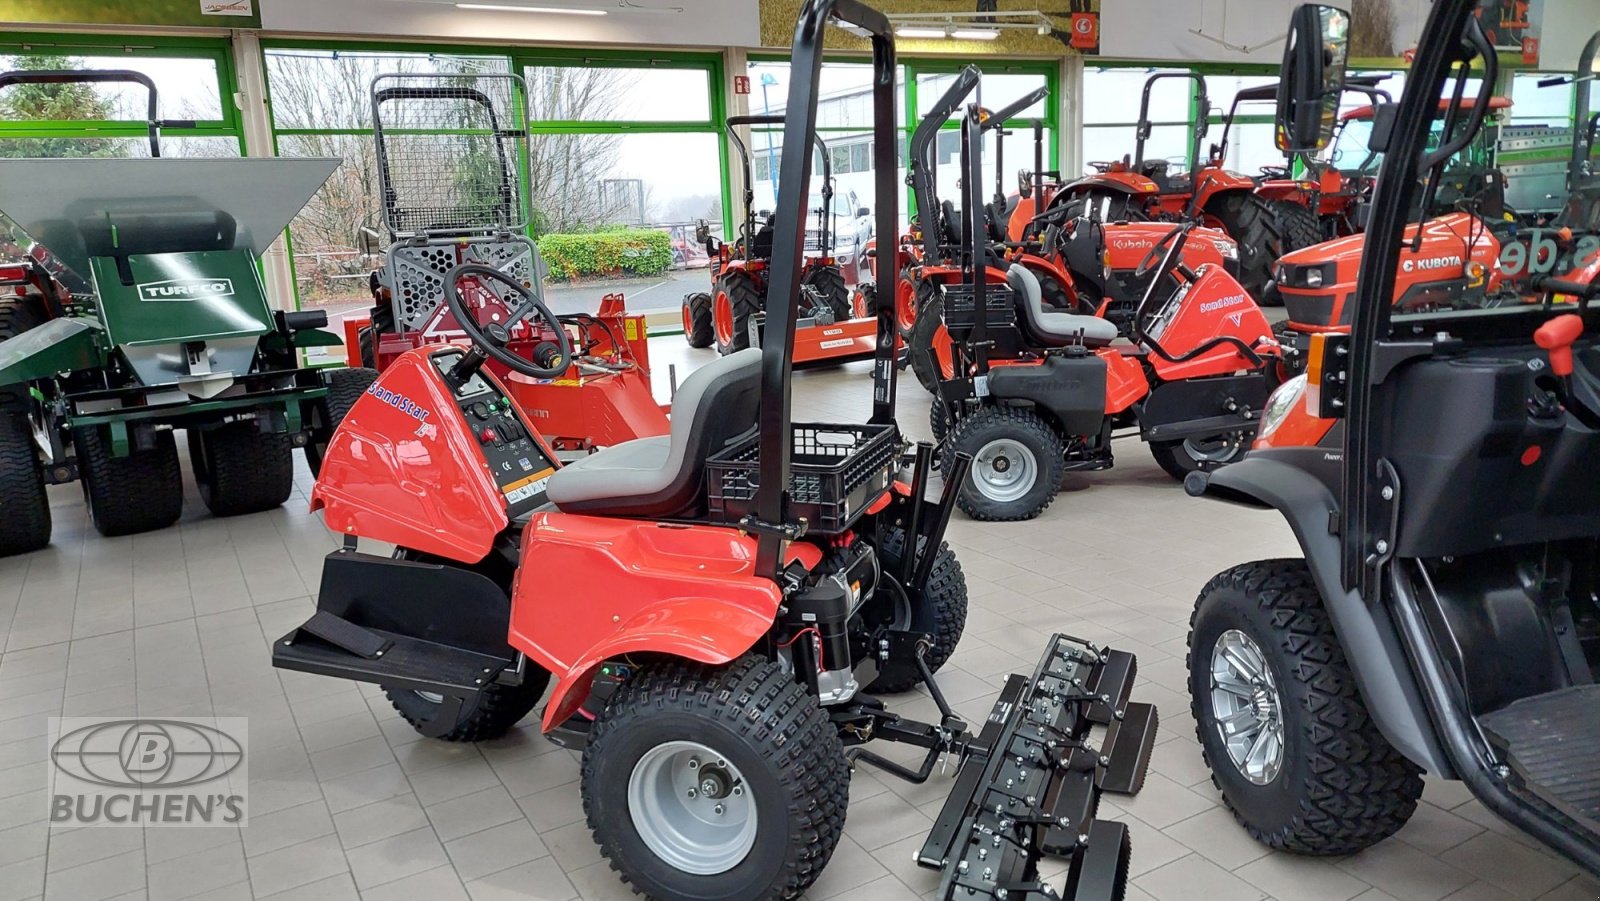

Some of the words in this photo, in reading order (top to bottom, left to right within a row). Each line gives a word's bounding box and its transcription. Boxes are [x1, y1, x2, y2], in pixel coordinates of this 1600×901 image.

[1113, 239, 1153, 249] Kubota
[1417, 256, 1462, 270] KUBOTA
[145, 283, 226, 297] TURFCO
[367, 382, 402, 407] Sand
[398, 397, 430, 422] Star
